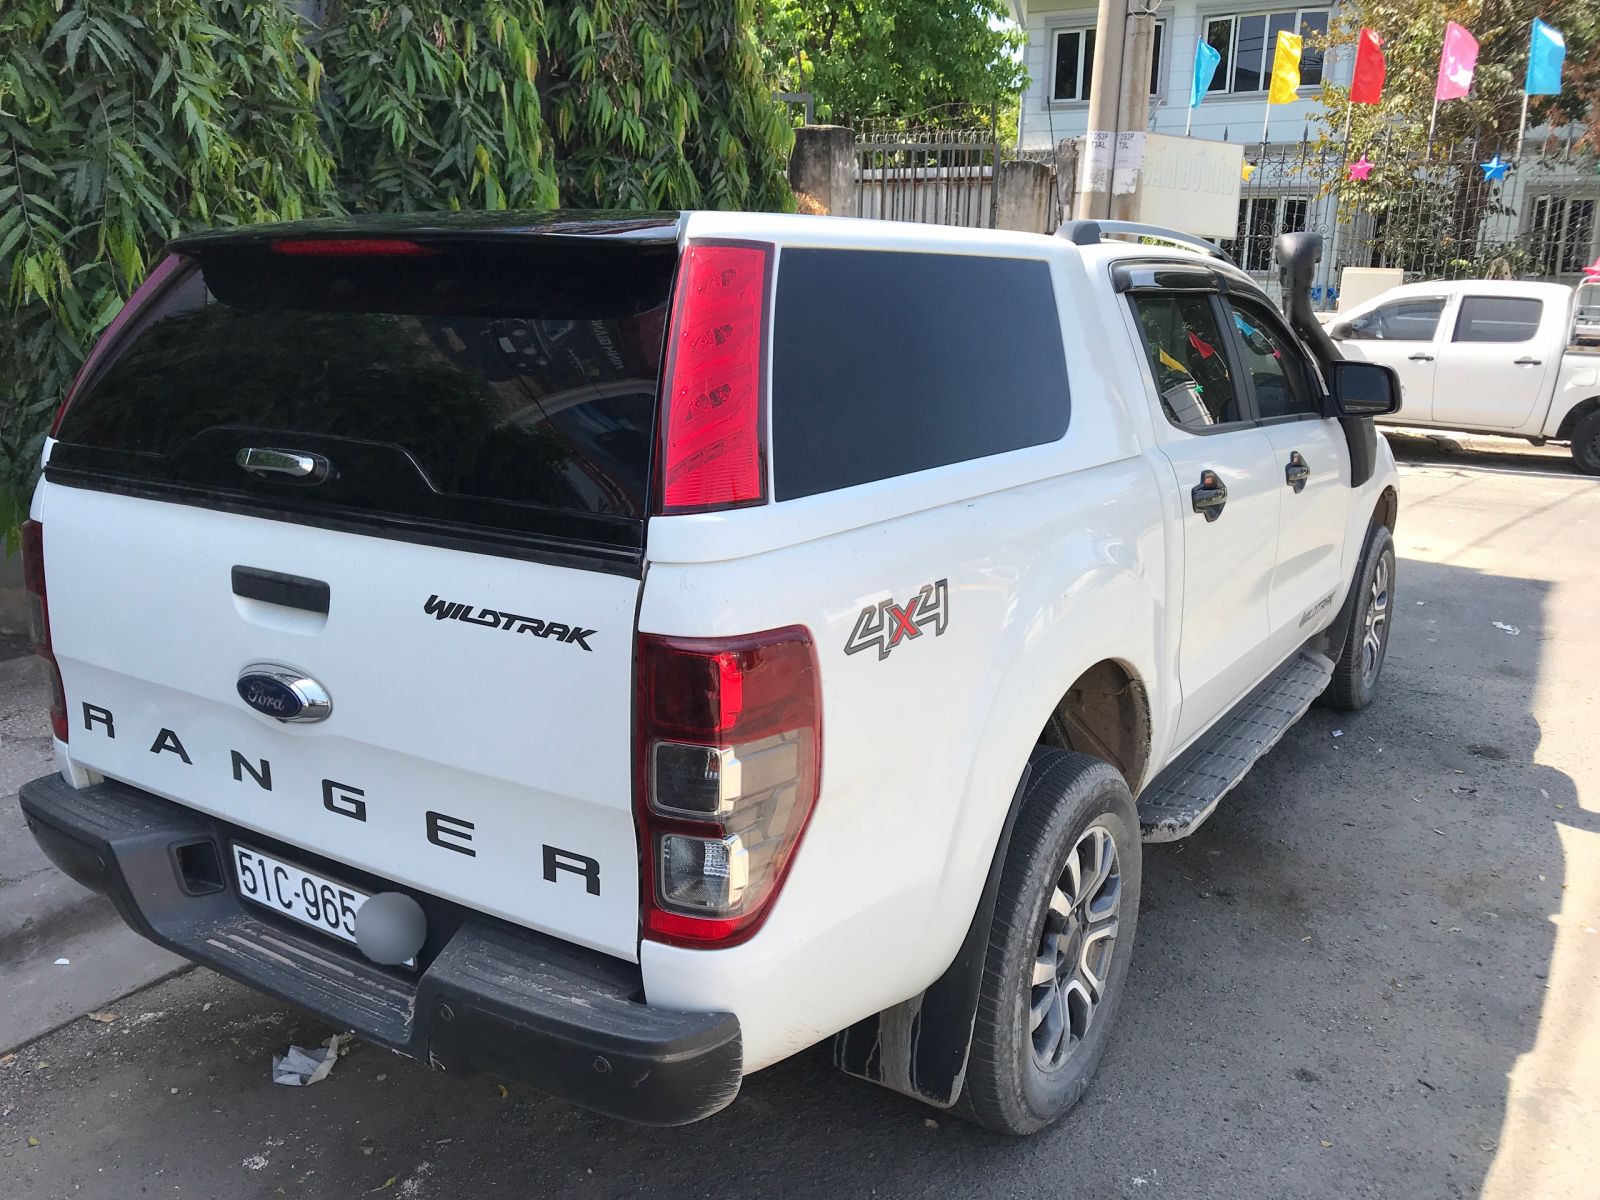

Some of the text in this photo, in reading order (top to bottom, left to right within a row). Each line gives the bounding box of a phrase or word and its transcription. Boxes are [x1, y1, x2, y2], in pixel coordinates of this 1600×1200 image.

[424, 595, 598, 652] WILDTRAK
[246, 679, 286, 711] Ford
[82, 702, 601, 896] RANGER
[237, 850, 356, 936] 51C-965
